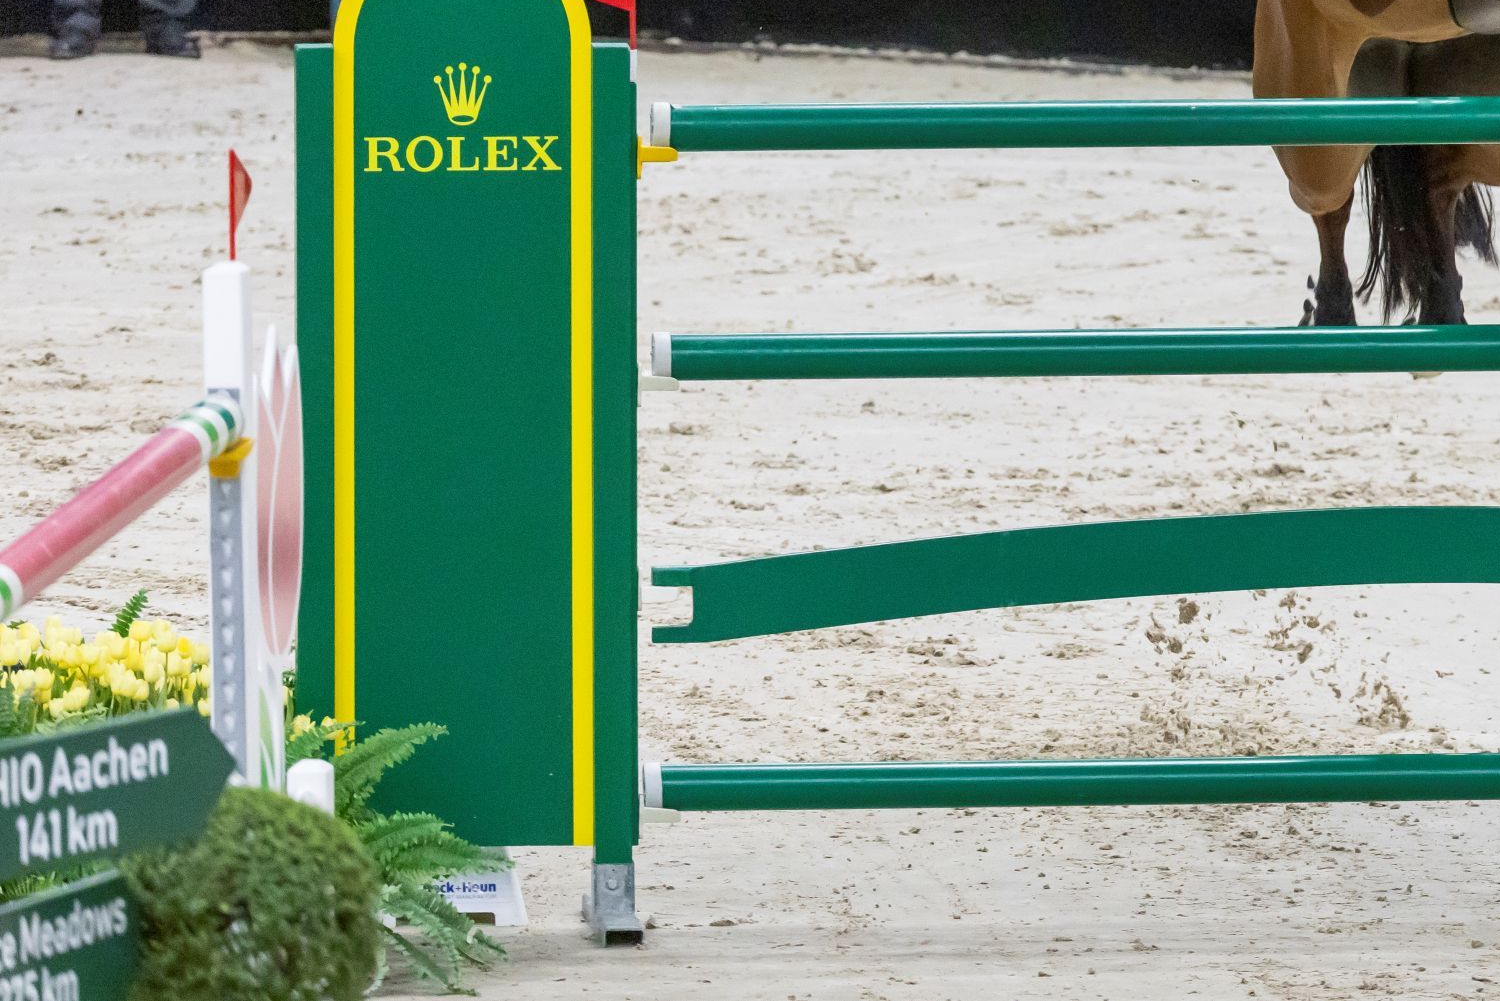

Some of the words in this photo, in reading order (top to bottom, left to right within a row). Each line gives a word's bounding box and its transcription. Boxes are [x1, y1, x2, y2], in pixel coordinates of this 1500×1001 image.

[364, 135, 562, 172] ROLEX
[49, 735, 169, 798] Aachen
[16, 808, 62, 866] 141
[67, 805, 119, 854] km
[20, 897, 127, 964] Meadows
